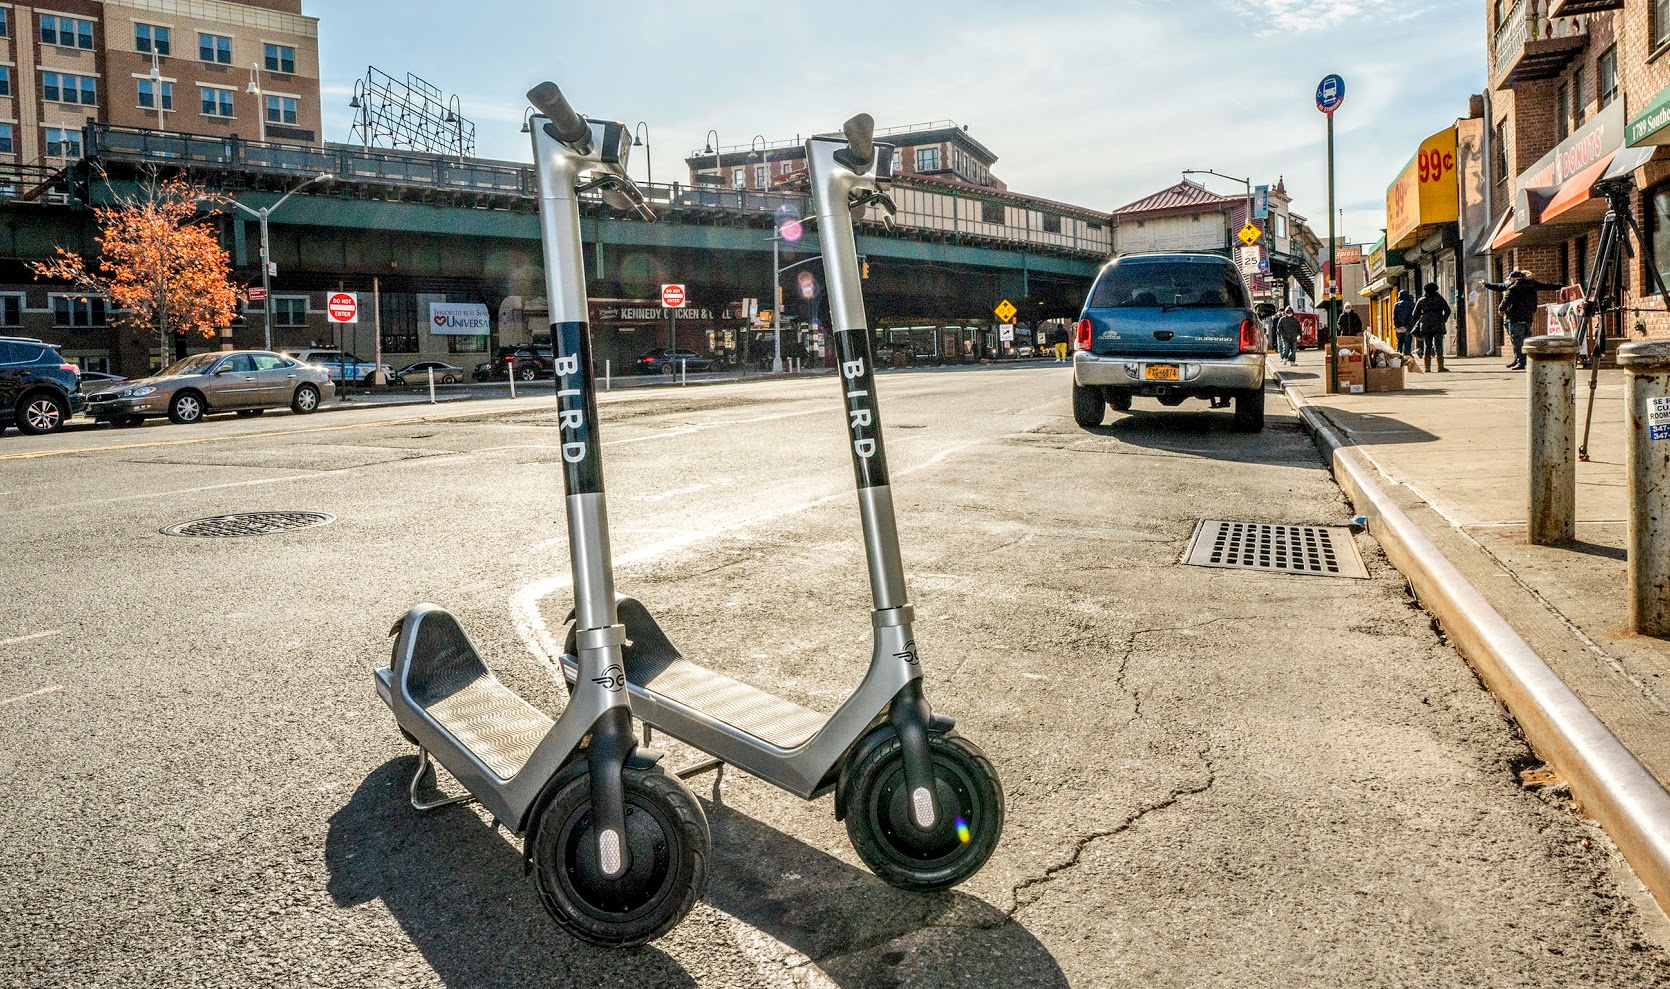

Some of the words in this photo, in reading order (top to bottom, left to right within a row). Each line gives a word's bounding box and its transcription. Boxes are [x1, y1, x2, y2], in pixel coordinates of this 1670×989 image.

[1323, 96, 1343, 112] STANDING
[1632, 119, 1647, 141] 1789
[1418, 148, 1453, 183] 99¢
[1563, 127, 1602, 178] DONUTS
[1244, 256, 1258, 266] 25
[621, 308, 661, 319] KENNEDY
[663, 308, 699, 319] CICKEN
[701, 308, 708, 319] &
[555, 353, 586, 463] BIRD
[843, 357, 876, 458] BIRD
